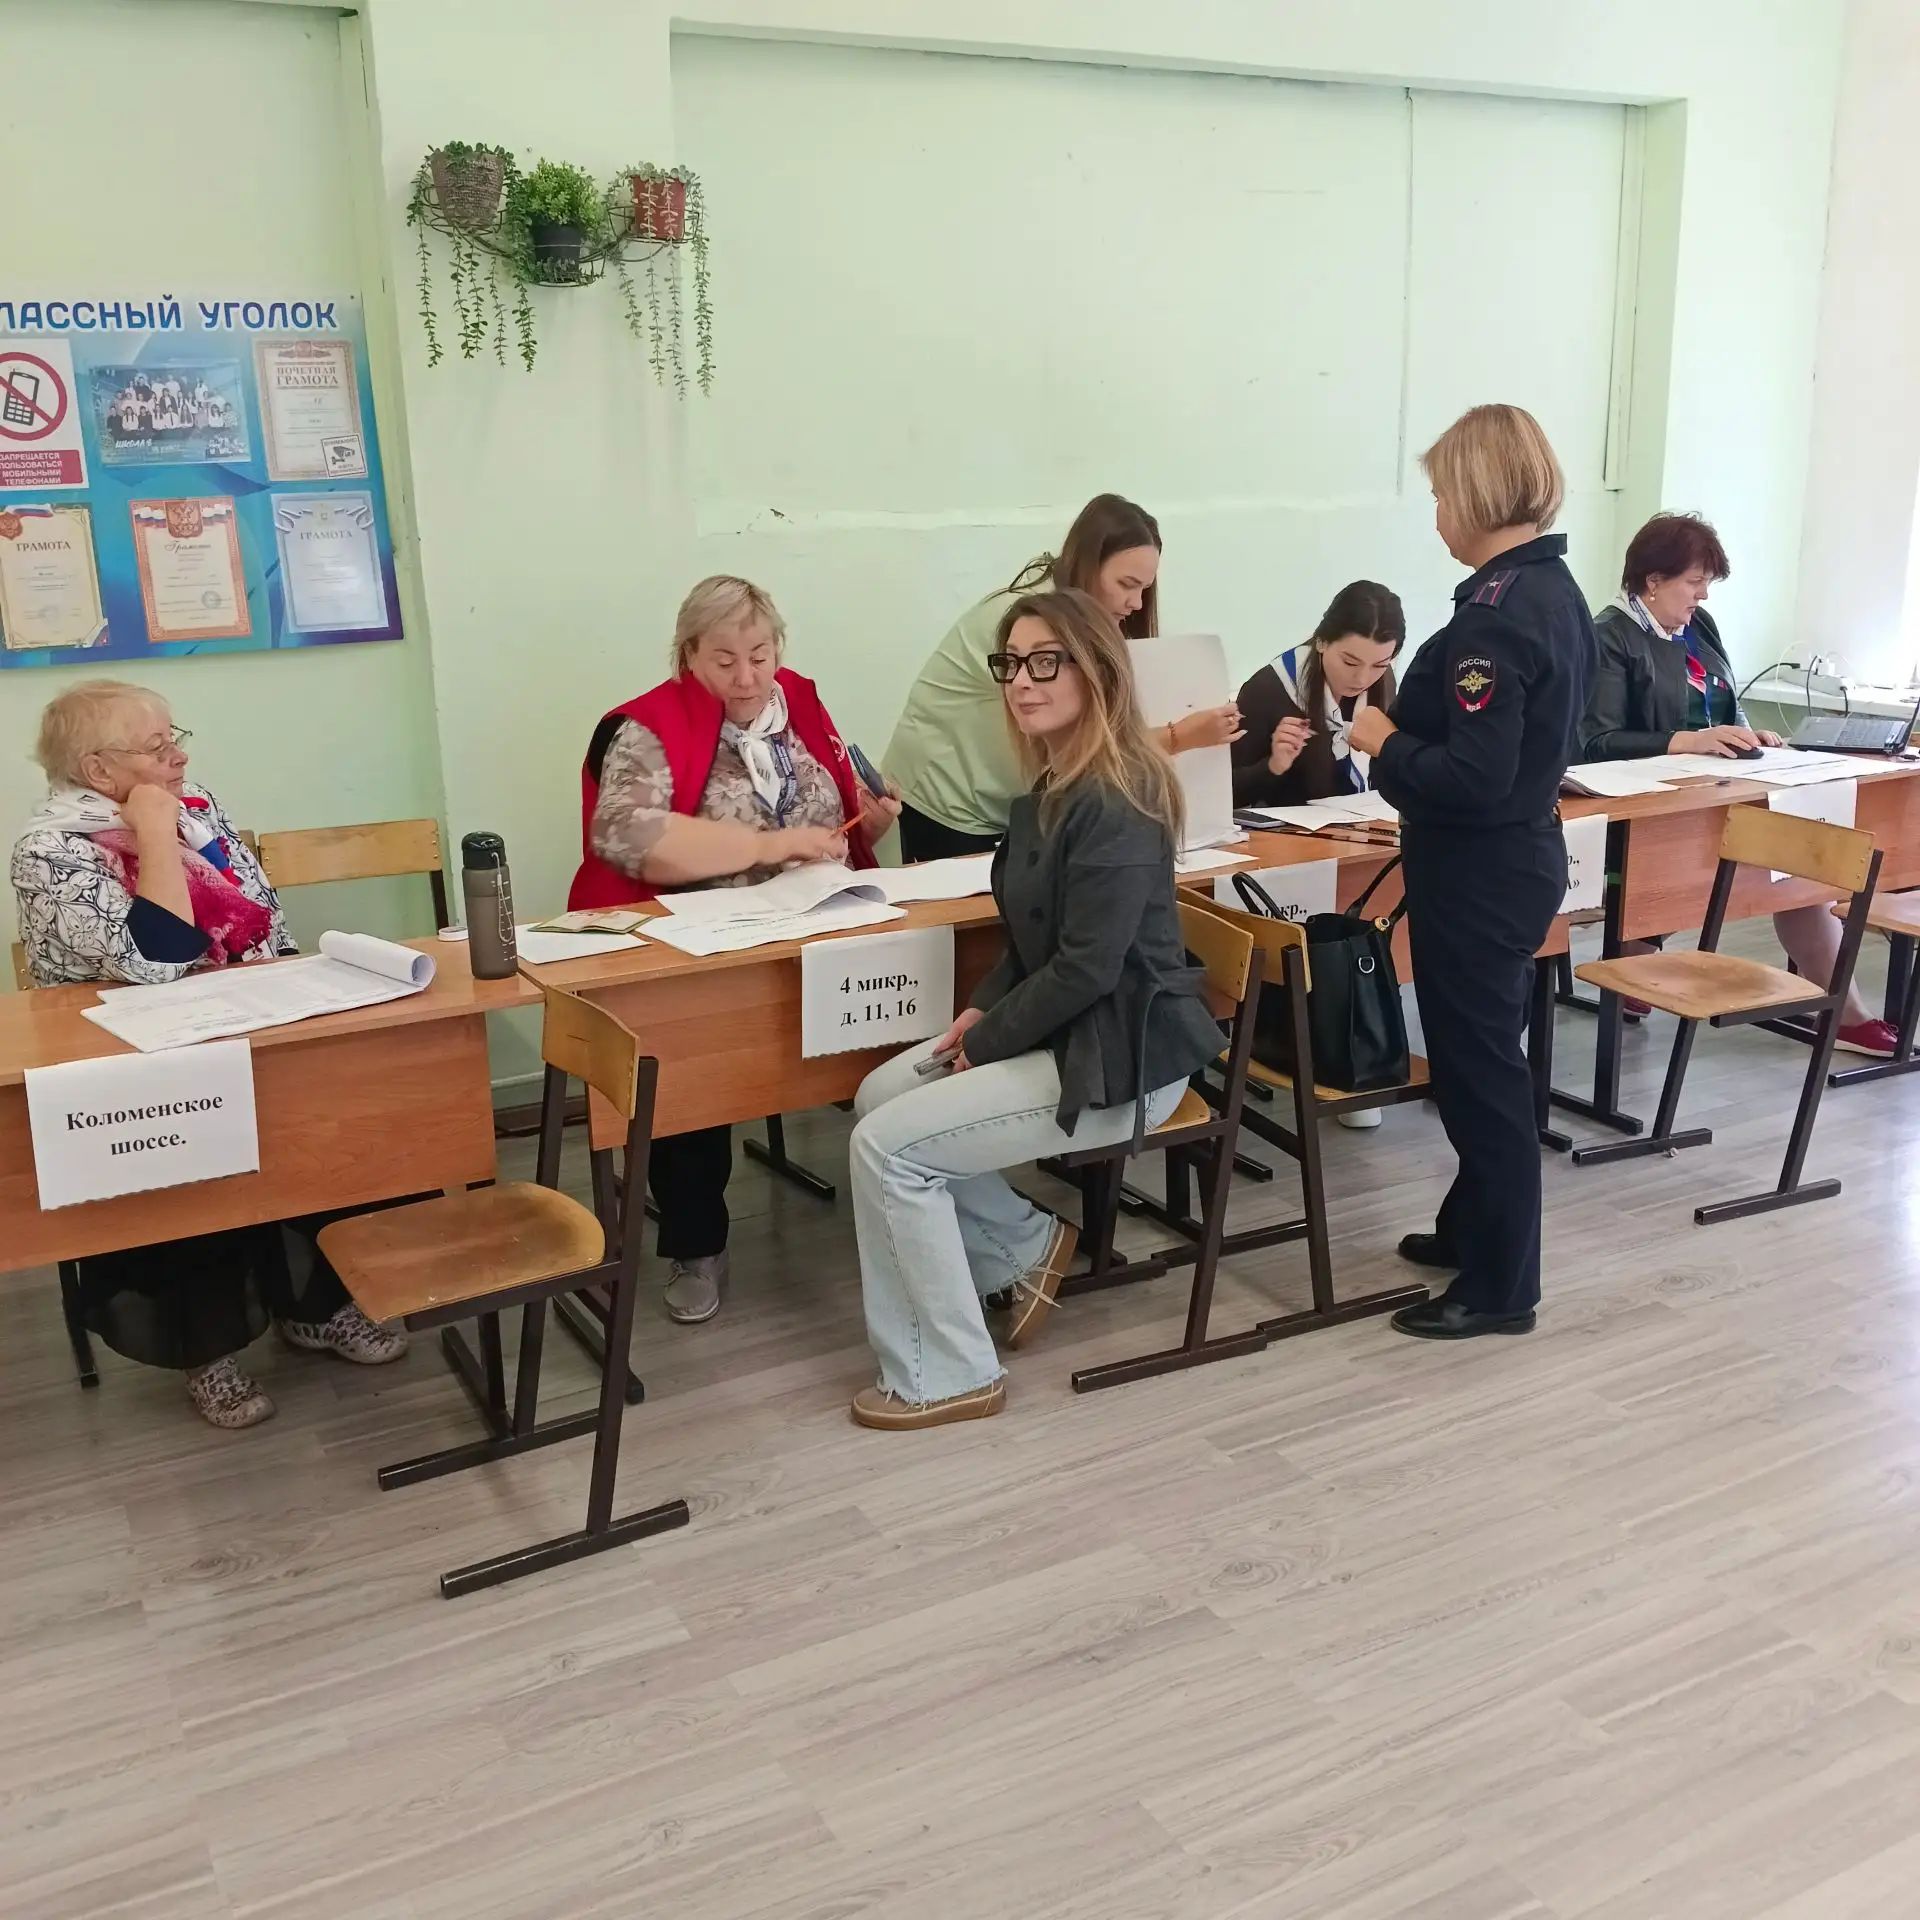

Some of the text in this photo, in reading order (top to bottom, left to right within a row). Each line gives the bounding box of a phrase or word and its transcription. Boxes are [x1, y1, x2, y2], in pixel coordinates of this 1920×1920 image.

[198, 302, 337, 329] УГОЛОК
[276, 375, 338, 386] ГРАМОТА
[2, 469, 62, 477] МОБИЛЬНЫМИ
[5, 477, 61, 486] ТЕЛЕФОНАМИ
[299, 530, 353, 541] ГРАМОТА
[16, 541, 71, 552] ГРАМОТА
[163, 540, 212, 554] Грам
[1458, 657, 1491, 671] РОССИЯ
[840, 974, 919, 994] 4 микр.,
[840, 997, 917, 1027] д. 11, 16
[65, 1096, 223, 1130] Коломенское
[110, 1132, 187, 1156] шоссе.
